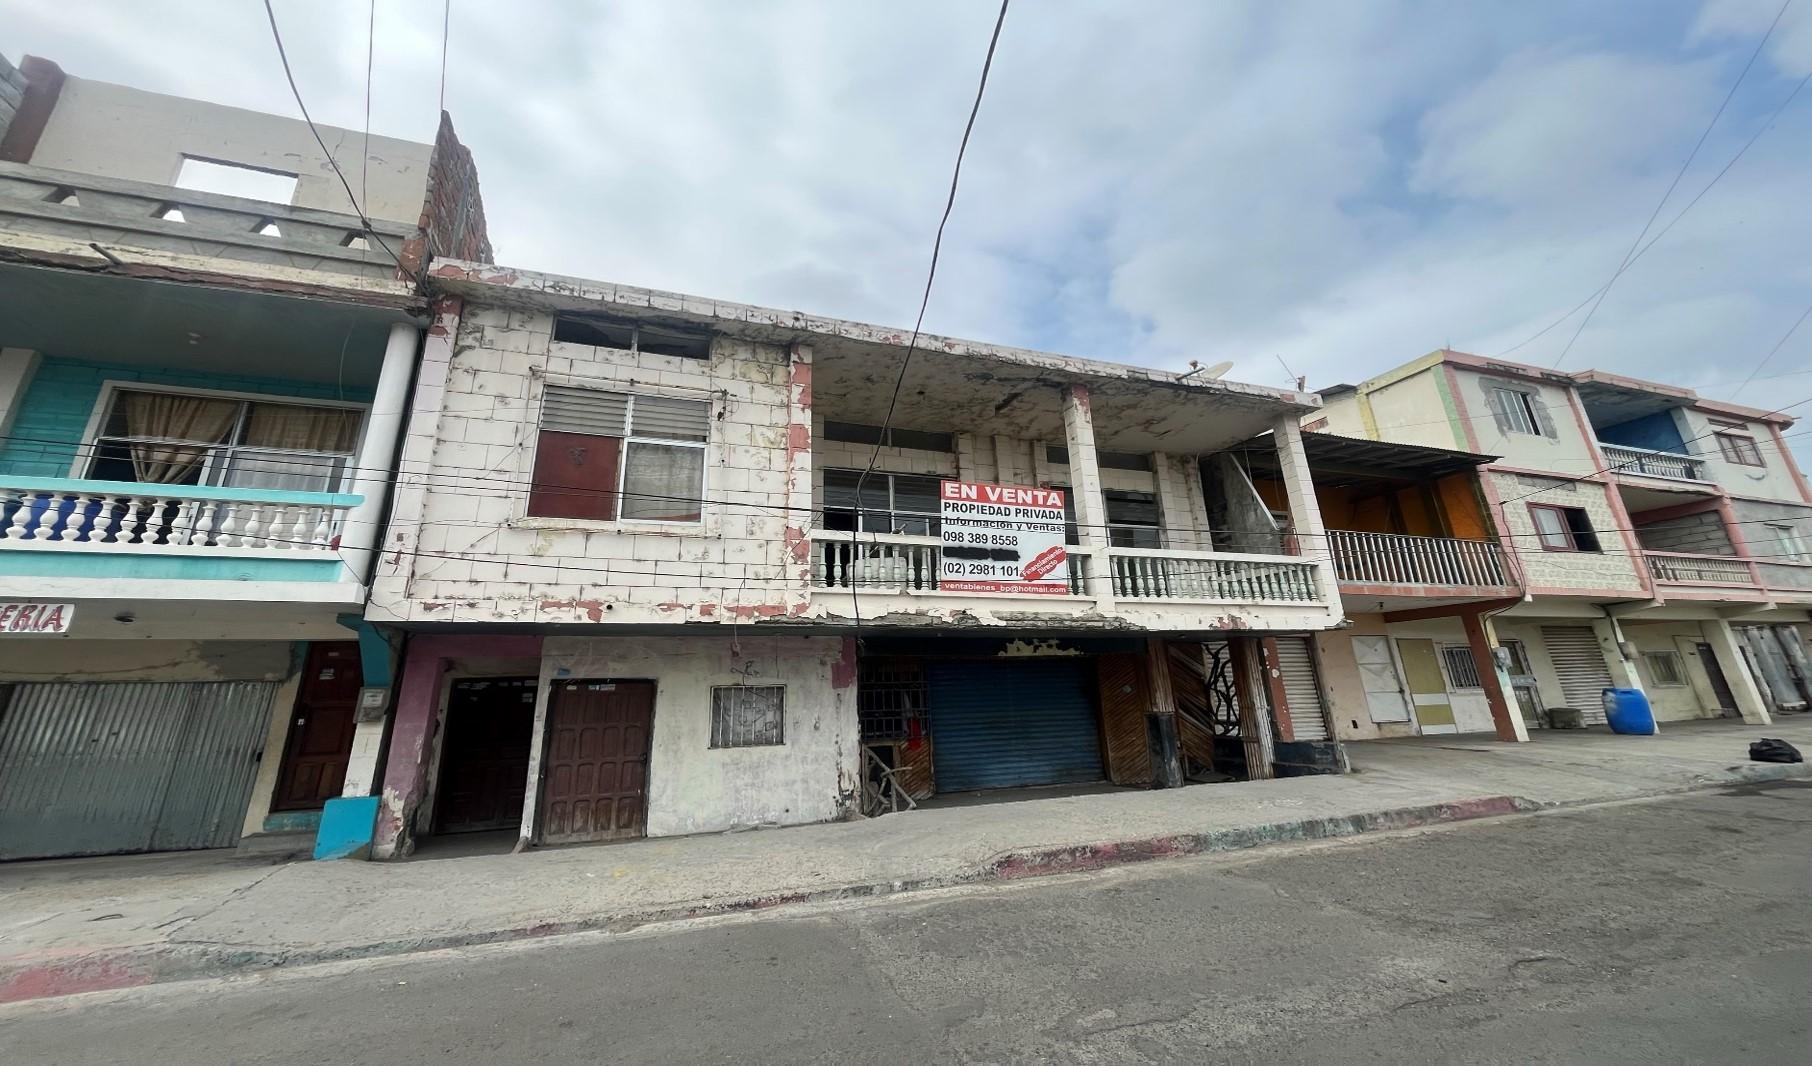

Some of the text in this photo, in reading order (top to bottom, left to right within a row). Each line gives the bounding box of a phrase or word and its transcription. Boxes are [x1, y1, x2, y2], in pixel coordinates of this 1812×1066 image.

[945, 482, 1062, 507] EN VENTA
[943, 502, 1063, 521] PROPIEDAD PRIVADA
[1016, 523, 1023, 531] y
[1026, 522, 1065, 533] Ventas:
[943, 531, 1018, 546] 098 389 8558
[943, 562, 1019, 577] (02) 2981 101
[0, 605, 65, 631] ERIA
